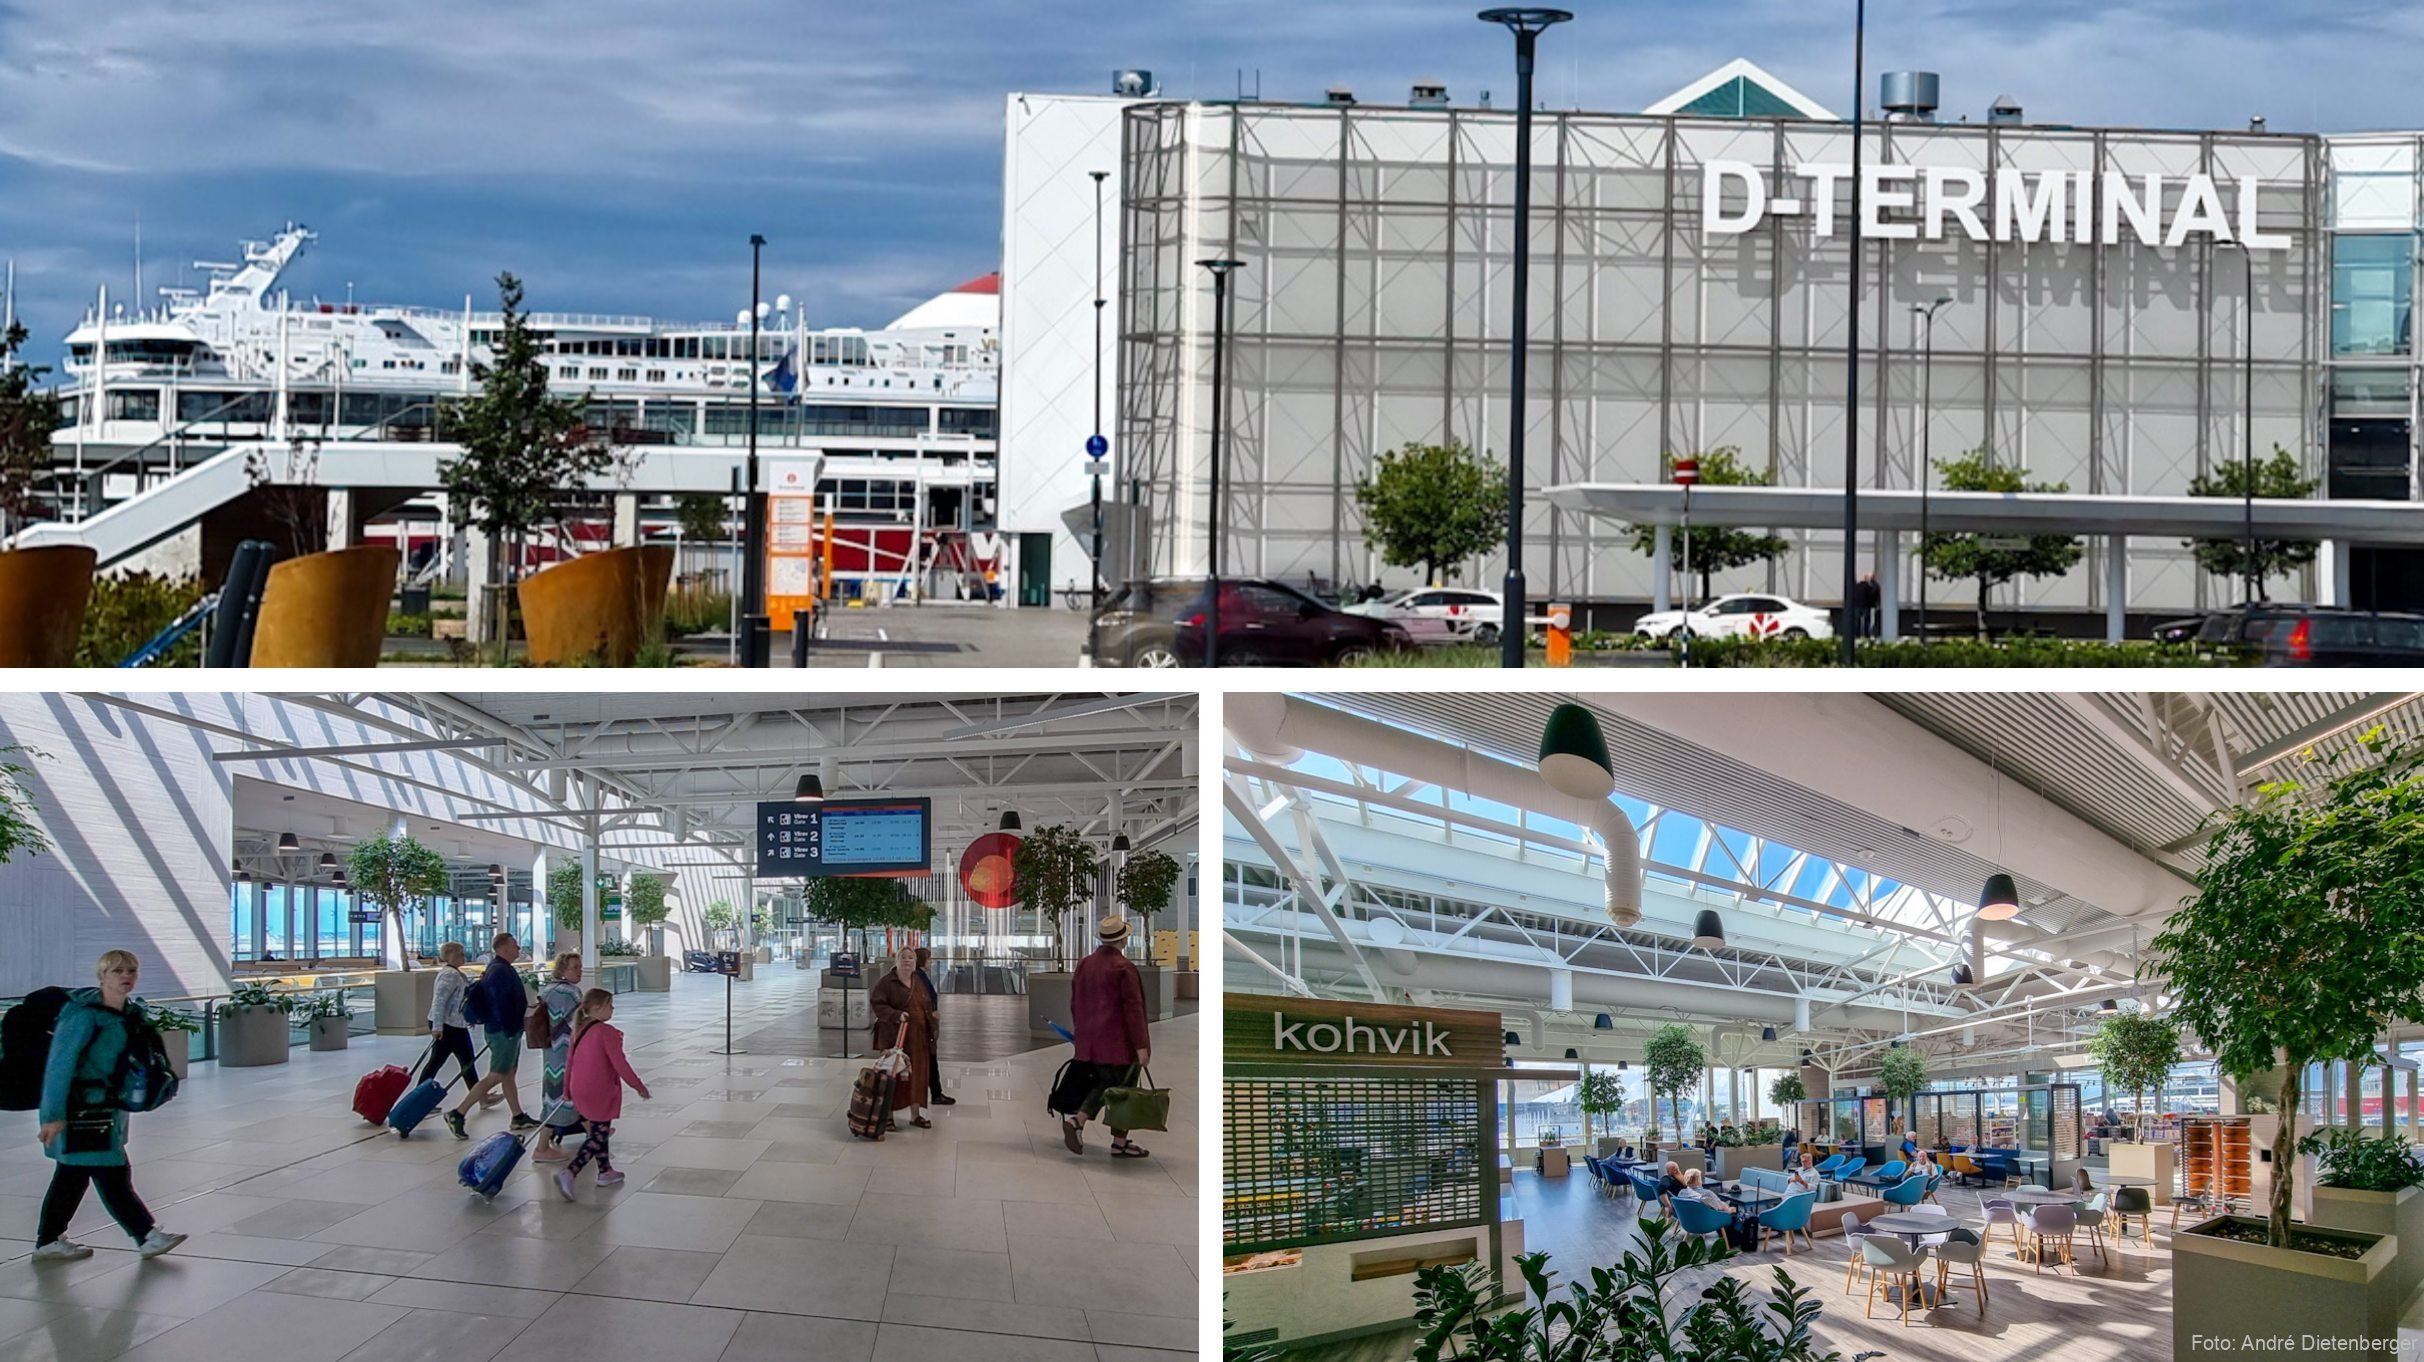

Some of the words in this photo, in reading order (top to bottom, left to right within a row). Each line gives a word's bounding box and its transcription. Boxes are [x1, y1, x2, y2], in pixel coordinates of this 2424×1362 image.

[1703, 160, 2292, 249] D-TERMINAL
[810, 813, 818, 824] 1
[810, 831, 818, 842] 2
[810, 847, 818, 858] 3
[1274, 1011, 1452, 1056] kohvik
